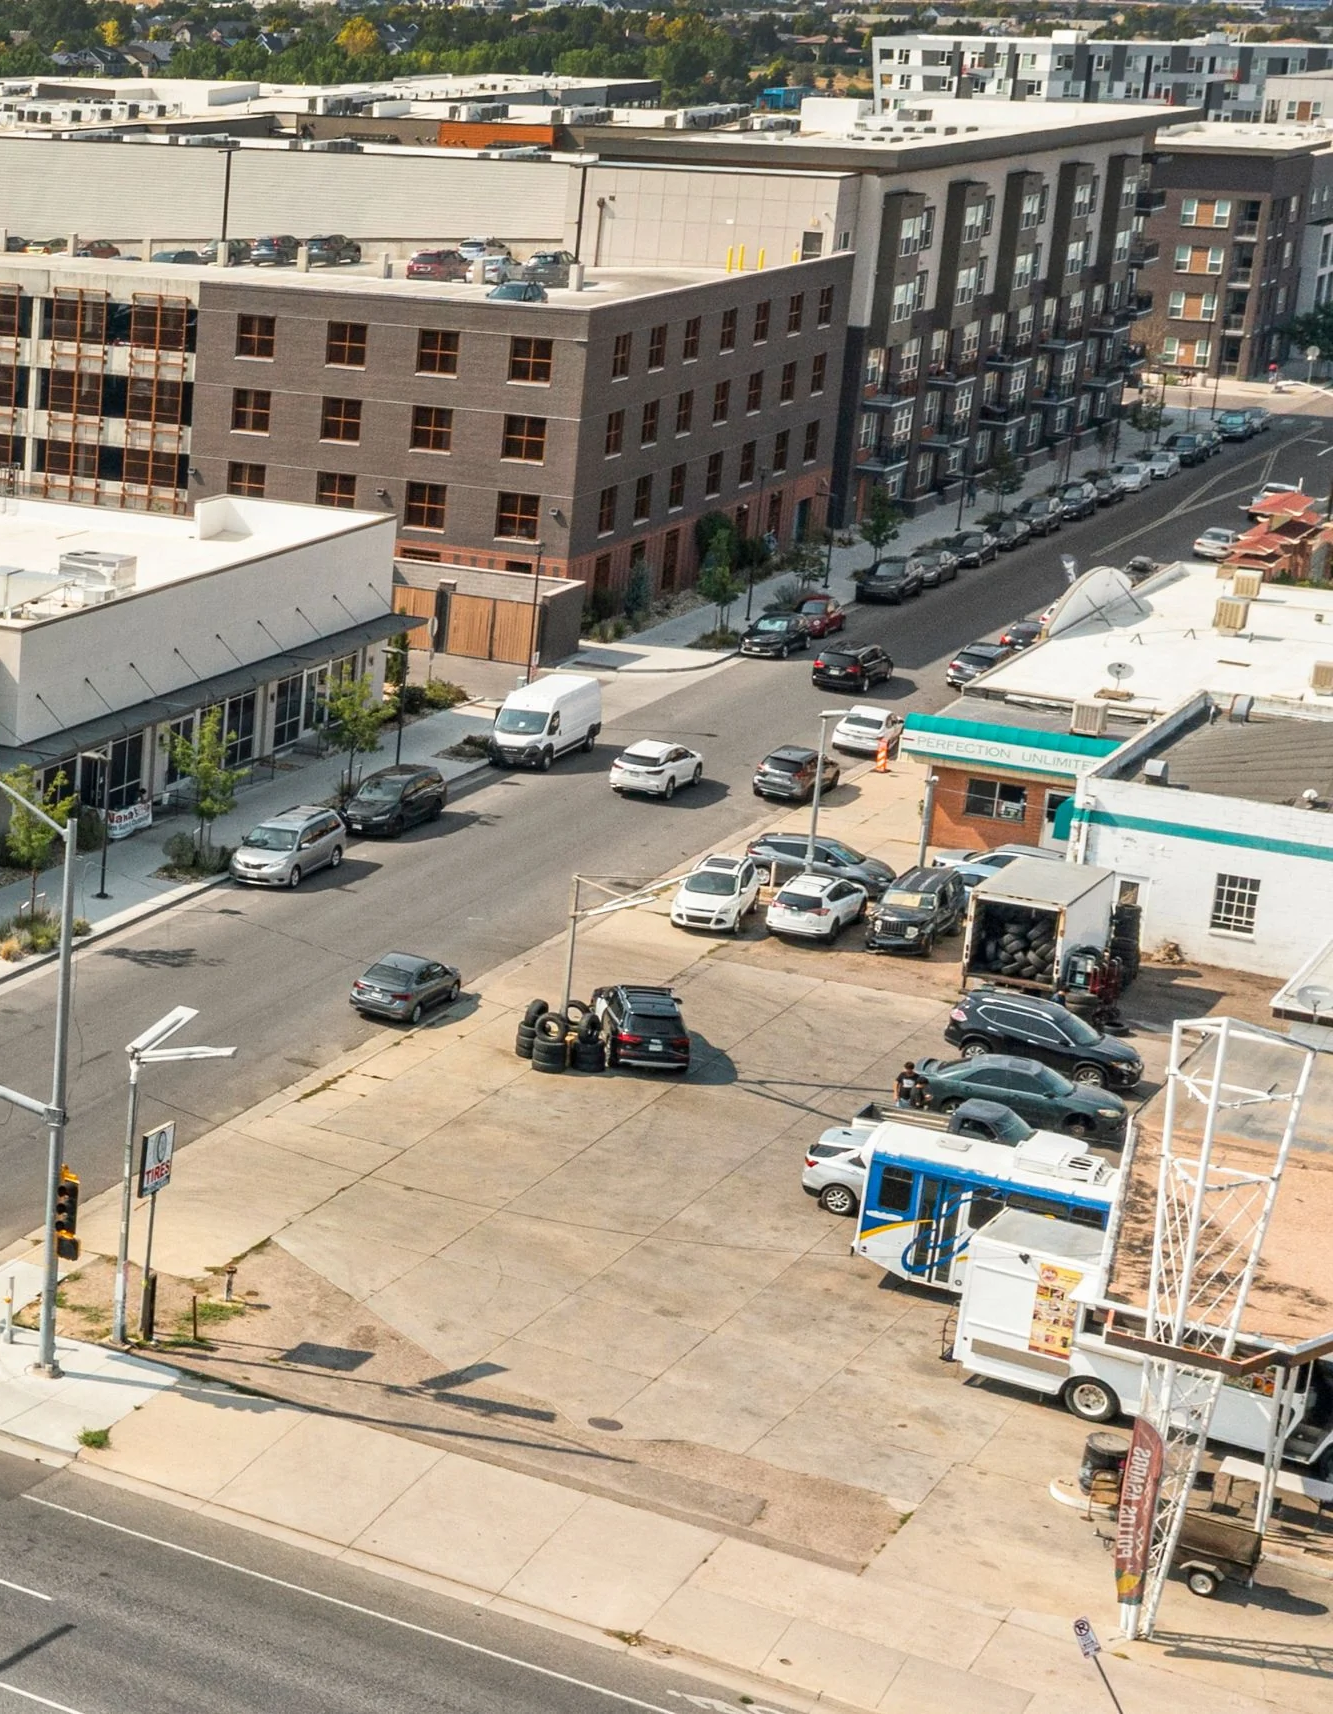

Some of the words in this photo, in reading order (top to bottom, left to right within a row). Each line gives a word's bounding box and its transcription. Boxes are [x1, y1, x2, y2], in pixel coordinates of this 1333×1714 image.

[916, 735, 1012, 759] PERFECTION
[1021, 751, 1097, 772] UNLIMITE
[145, 1160, 170, 1185] TIRES
